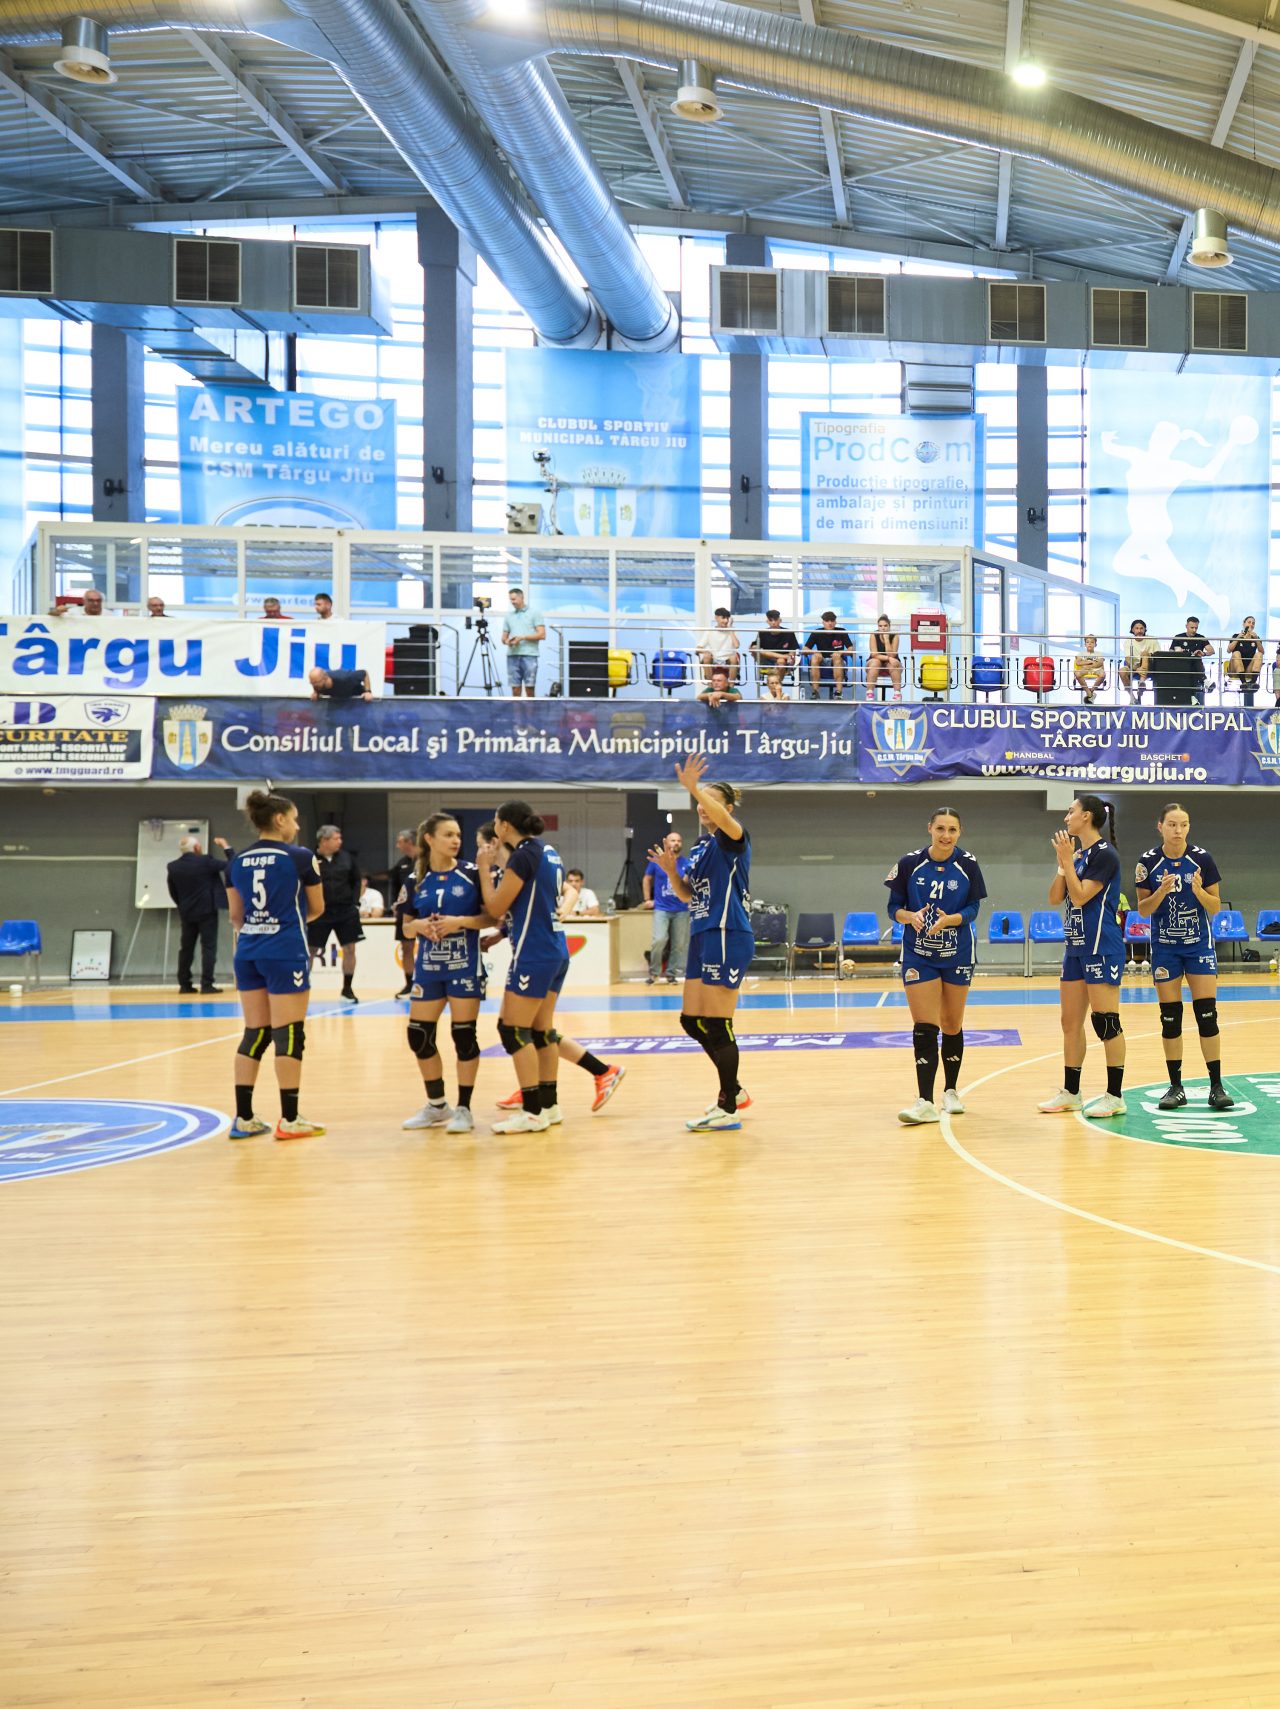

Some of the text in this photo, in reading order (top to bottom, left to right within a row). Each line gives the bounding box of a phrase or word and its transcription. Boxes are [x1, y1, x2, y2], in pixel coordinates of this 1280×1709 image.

[189, 393, 384, 430] ARTEGO
[538, 416, 670, 433] CLUBUL SPORTIV
[814, 422, 886, 436] Tipografia
[190, 436, 385, 461] Mereu alături de
[520, 432, 687, 448] MUNICIPAL TÂRGU JIU
[202, 460, 375, 485] CSM Târgu Jiu
[893, 476, 968, 492] tipografie,
[816, 496, 886, 511] ambalaje
[913, 496, 968, 512] printuri
[816, 516, 968, 530] de mari dimensiuni!
[0, 622, 357, 690] ârgu Jiu
[932, 709, 1253, 731] CLUBUL SPORTIV MUNICIPAL
[0, 730, 129, 743] URITATE
[221, 724, 343, 754] Consiliul
[351, 725, 420, 754] Local
[456, 726, 562, 754] Primăria
[567, 728, 729, 759] Municipiului
[736, 729, 853, 760] Târgu-Jiu
[1040, 729, 1149, 748] TÂRGU JIU
[1013, 752, 1054, 760] HANDBAL
[981, 762, 1208, 784] www.csmtargujiu.ro
[251, 869, 267, 910] 5
[435, 888, 445, 908] 7
[929, 880, 945, 900] 21
